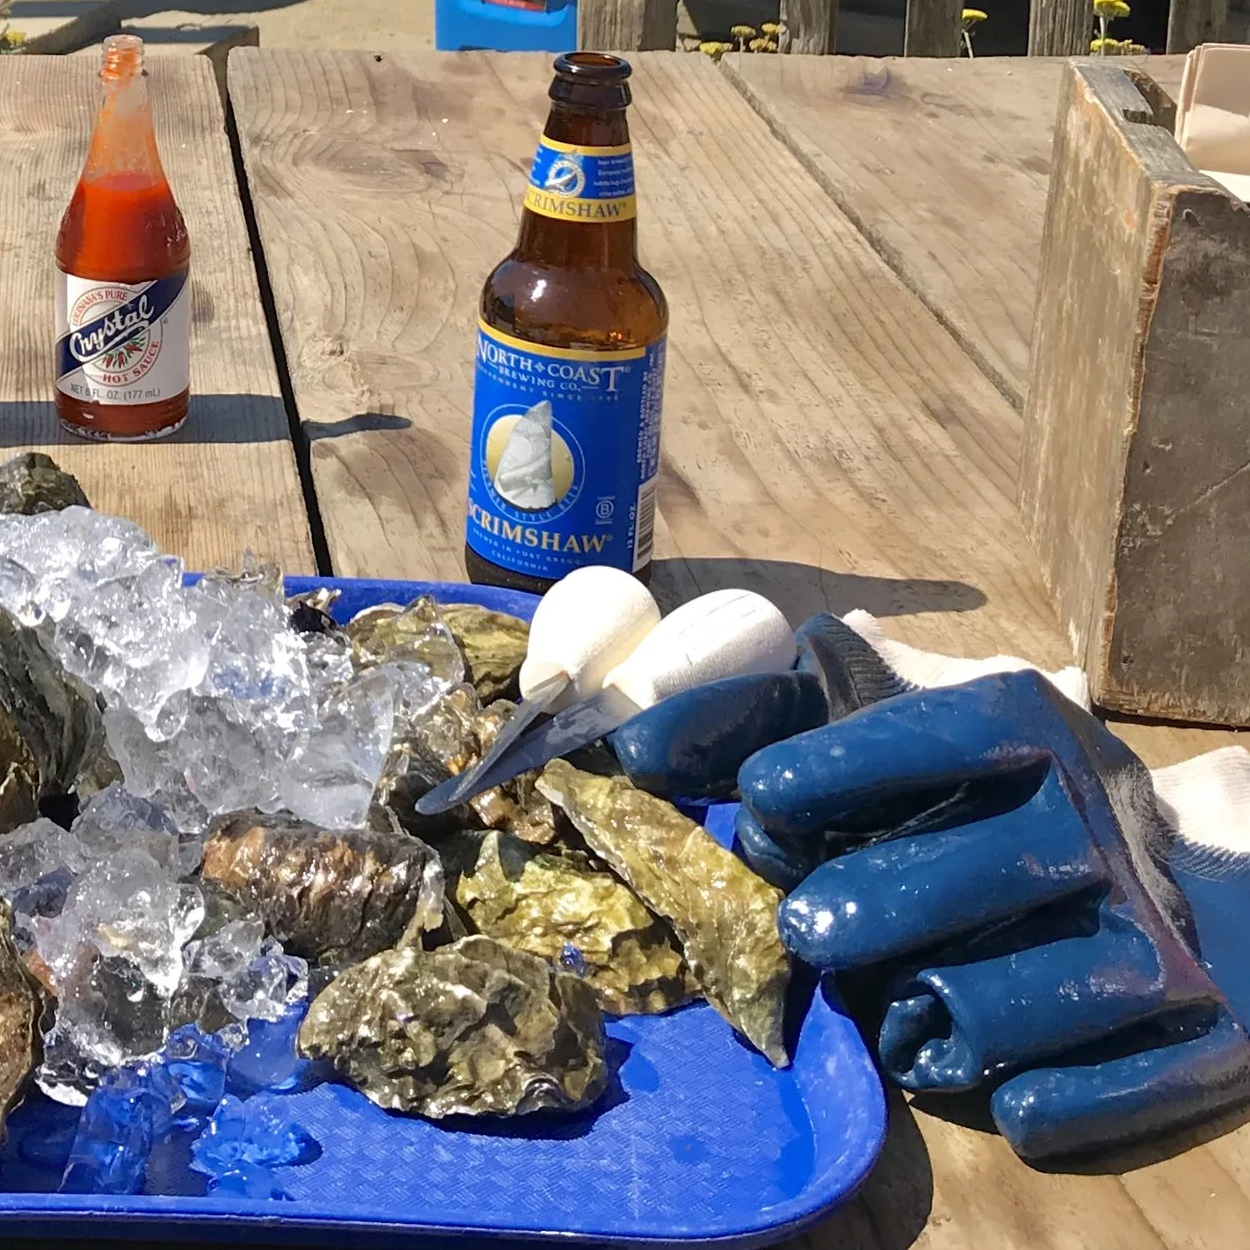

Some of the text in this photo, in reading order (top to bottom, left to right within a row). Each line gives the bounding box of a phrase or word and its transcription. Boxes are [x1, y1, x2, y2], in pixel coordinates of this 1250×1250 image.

[528, 191, 621, 218] CRIMSHAW
[104, 289, 128, 301] PURE
[69, 294, 156, 363] Crystal
[102, 340, 160, 384] HOT SAUCE
[477, 332, 625, 392] NORTH COAST
[499, 366, 555, 389] BREWING
[71, 383, 83, 395] NET
[106, 390, 120, 400] OZ
[123, 390, 143, 402] (177
[145, 387, 161, 398] mL)
[491, 549, 549, 571] CALIFORNIA
